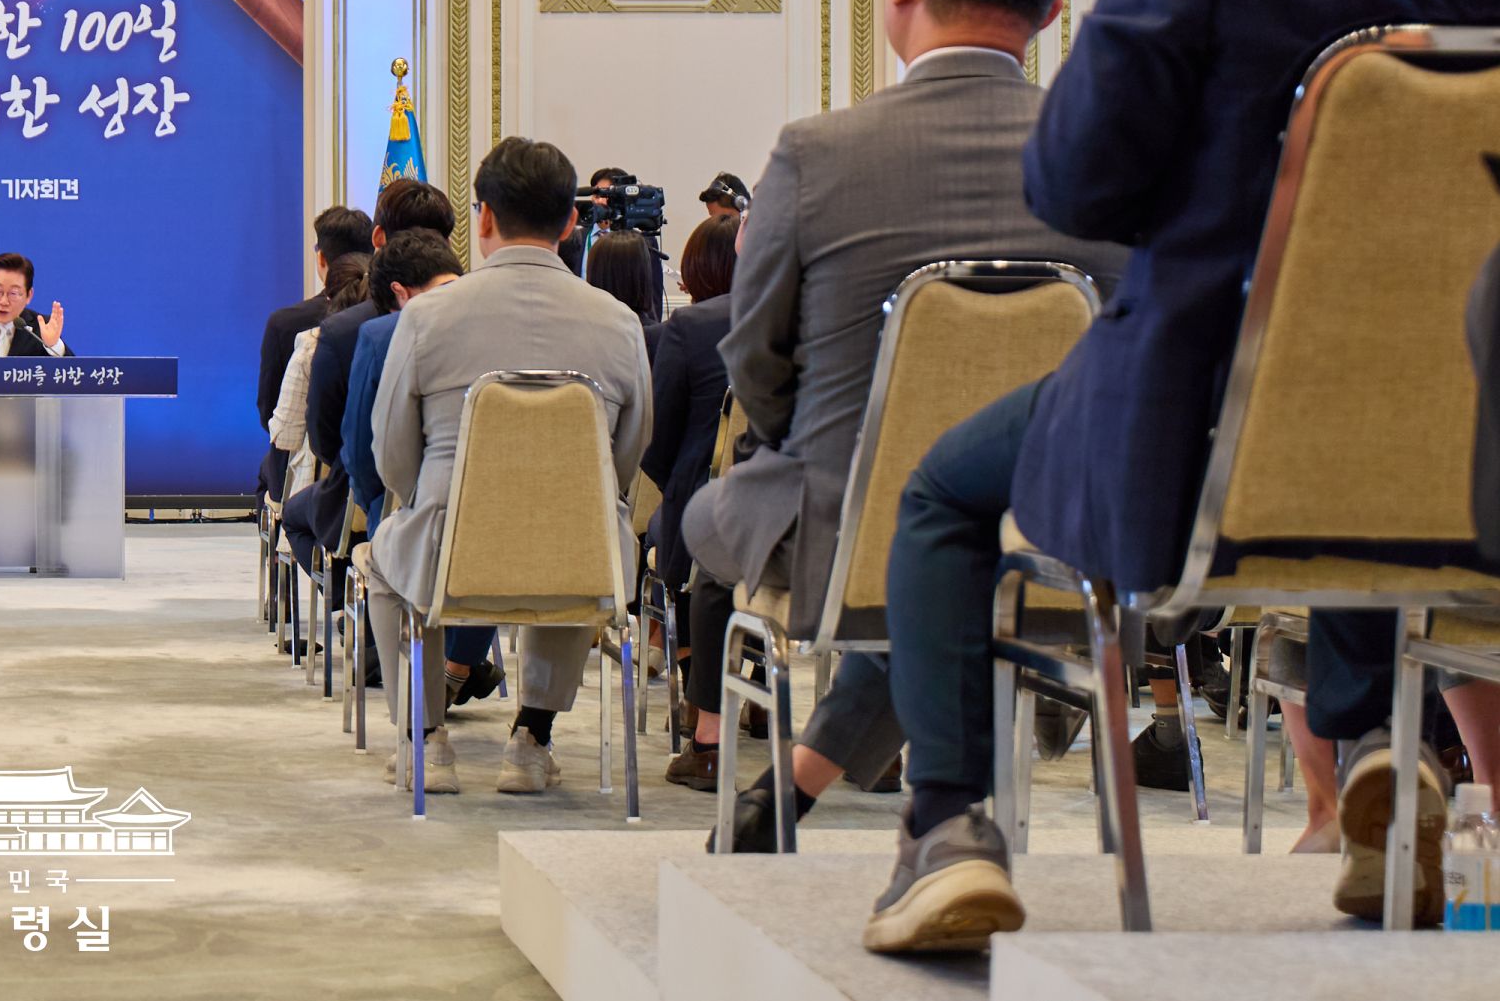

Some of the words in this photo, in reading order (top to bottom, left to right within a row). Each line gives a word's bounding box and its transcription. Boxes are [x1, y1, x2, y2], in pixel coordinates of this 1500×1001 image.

[59, 0, 178, 63] 100일
[78, 76, 190, 139] 성장
[0, 178, 79, 200] 기자회견
[3, 365, 47, 387] 미래를
[53, 366, 85, 386] 위한
[90, 366, 124, 386] 성장
